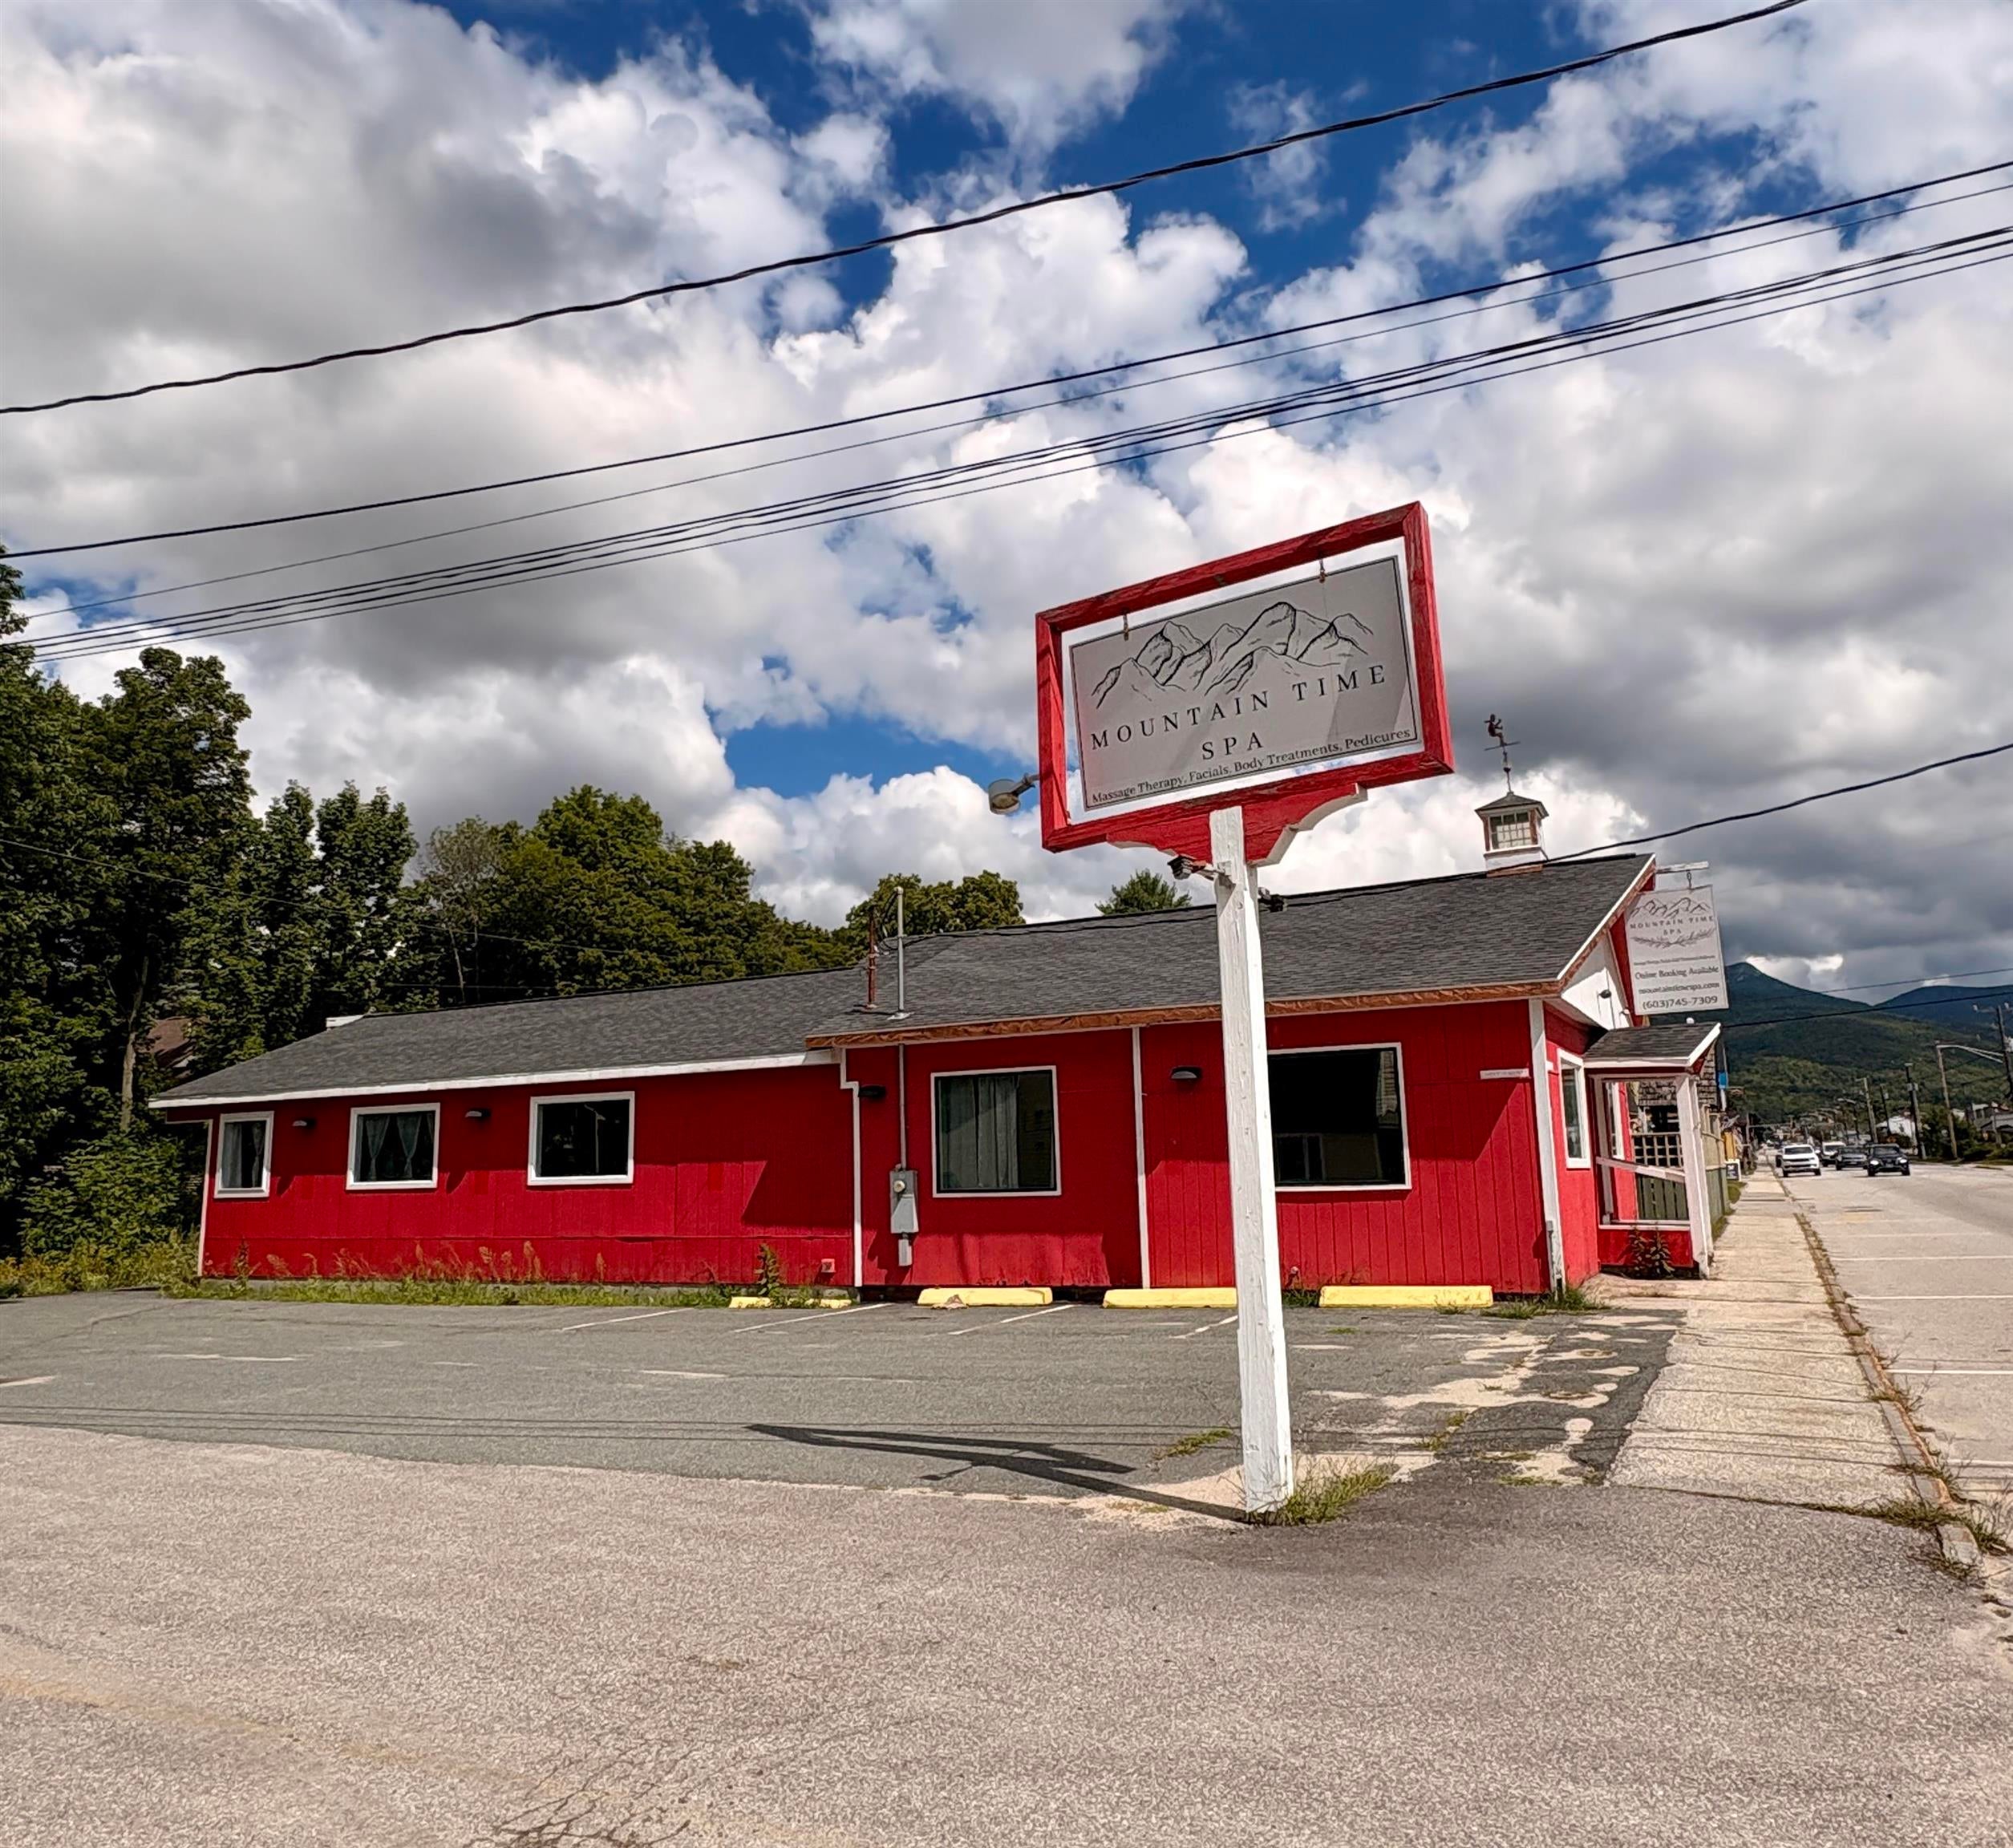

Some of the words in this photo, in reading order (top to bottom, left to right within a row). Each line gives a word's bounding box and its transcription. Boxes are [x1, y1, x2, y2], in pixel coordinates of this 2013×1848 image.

[1091, 690, 1270, 750] MOUNTAIN
[1292, 665, 1386, 702] TIME
[1201, 732, 1263, 760] SPA
[1092, 787, 1136, 803] Massage
[1138, 776, 1187, 793] Therapy,
[1233, 757, 1265, 772] Body
[1266, 742, 1343, 765] Treatments,
[1344, 727, 1411, 749] Pedicures
[1630, 919, 1683, 929] MOUNTAIN
[1659, 967, 1687, 977] Booking
[1642, 996, 1718, 1009] (603)745-7309
